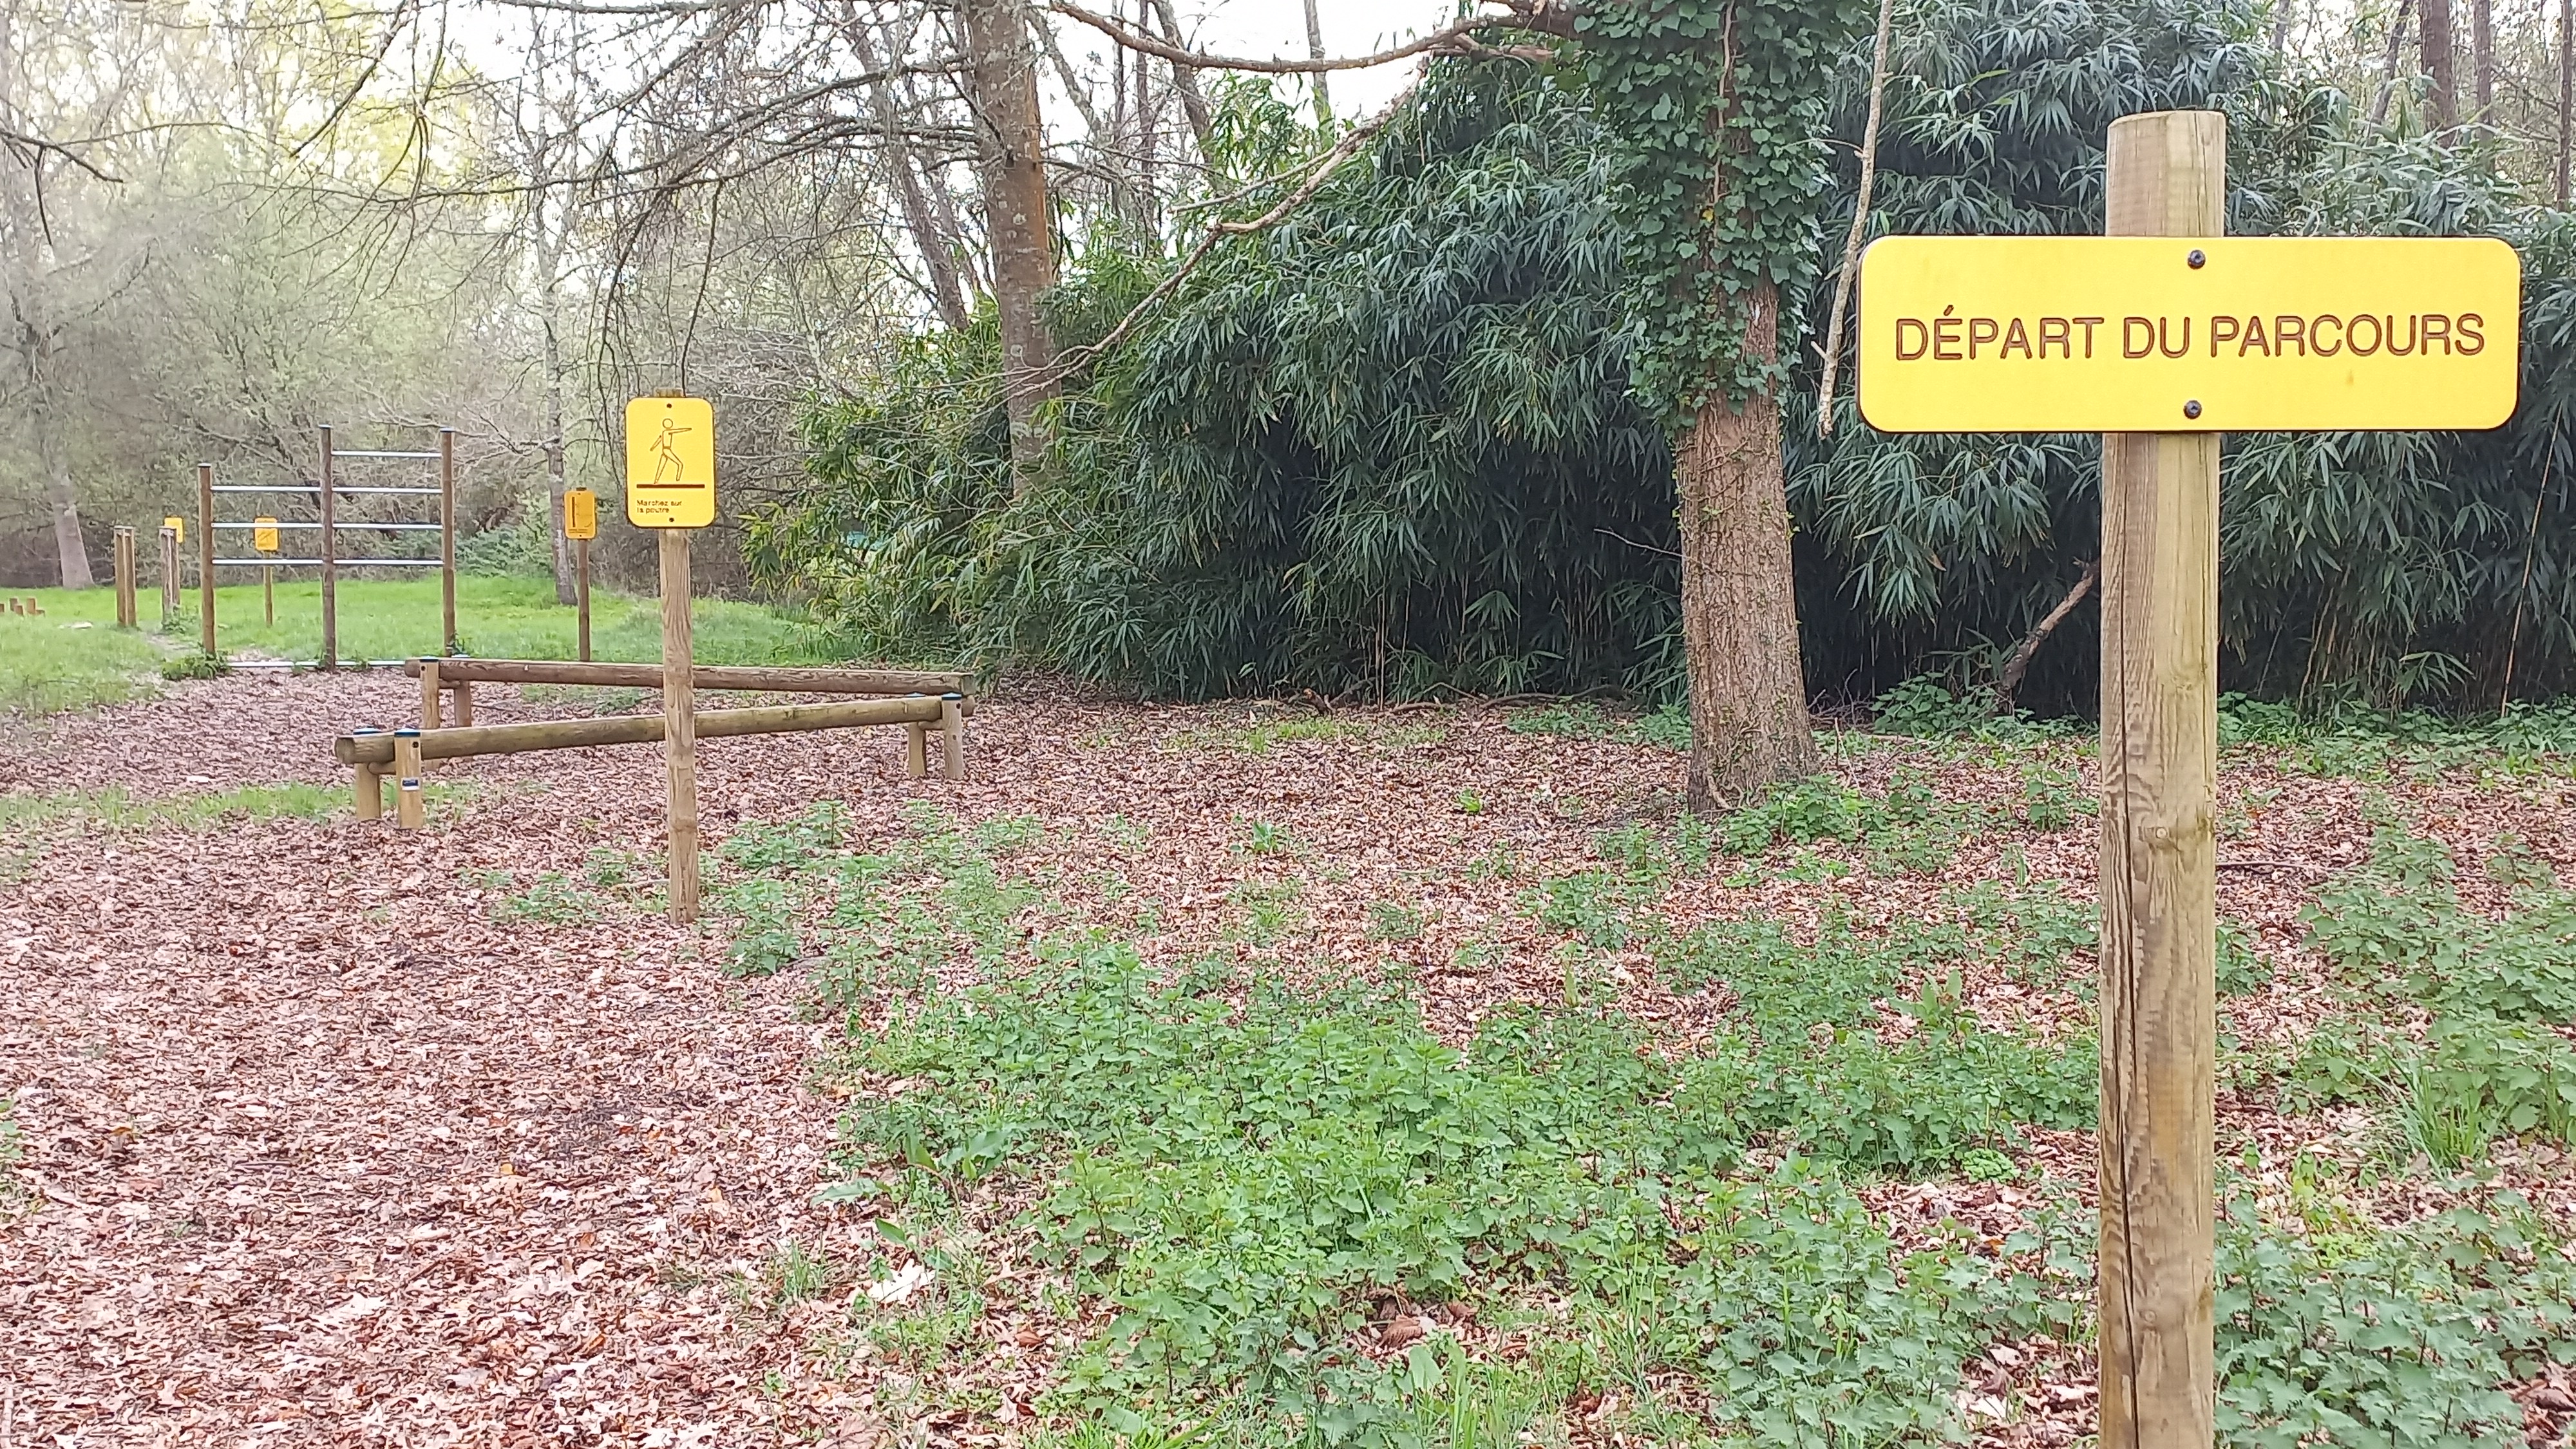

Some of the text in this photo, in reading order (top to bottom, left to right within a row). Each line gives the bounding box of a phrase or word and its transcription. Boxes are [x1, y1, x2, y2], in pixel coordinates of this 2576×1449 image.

[1895, 304, 2485, 361] DÉPART DU PARCOURS
